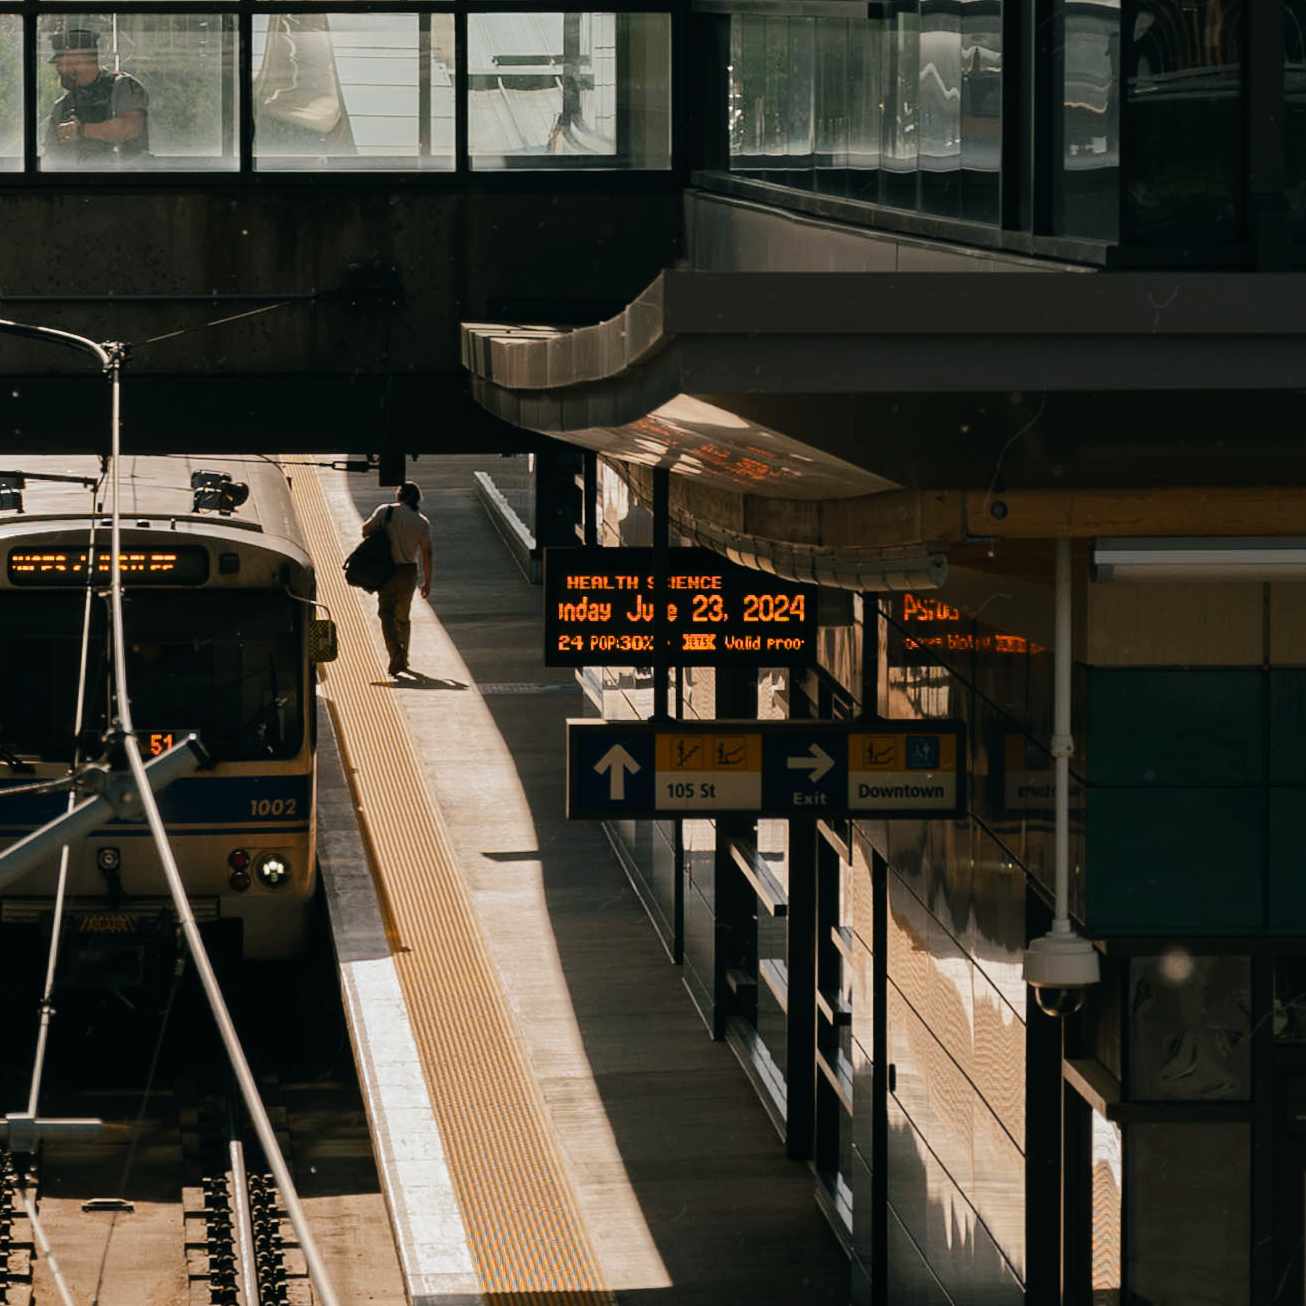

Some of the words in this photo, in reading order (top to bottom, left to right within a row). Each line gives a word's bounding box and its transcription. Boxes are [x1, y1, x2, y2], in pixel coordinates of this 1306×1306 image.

[566, 576, 639, 590] HEALTH
[646, 576, 723, 590] SIENCE
[626, 594, 678, 622] Jue
[692, 594, 729, 622] 23,
[743, 594, 806, 622] 2024
[558, 635, 584, 651] 24
[724, 635, 761, 651] Valid
[766, 638, 805, 651] proo
[150, 734, 173, 755] 51
[667, 783, 695, 798] 105
[700, 783, 716, 798] St
[793, 792, 827, 805] Exit
[858, 783, 945, 799] Downtown
[250, 798, 297, 816] 1002
